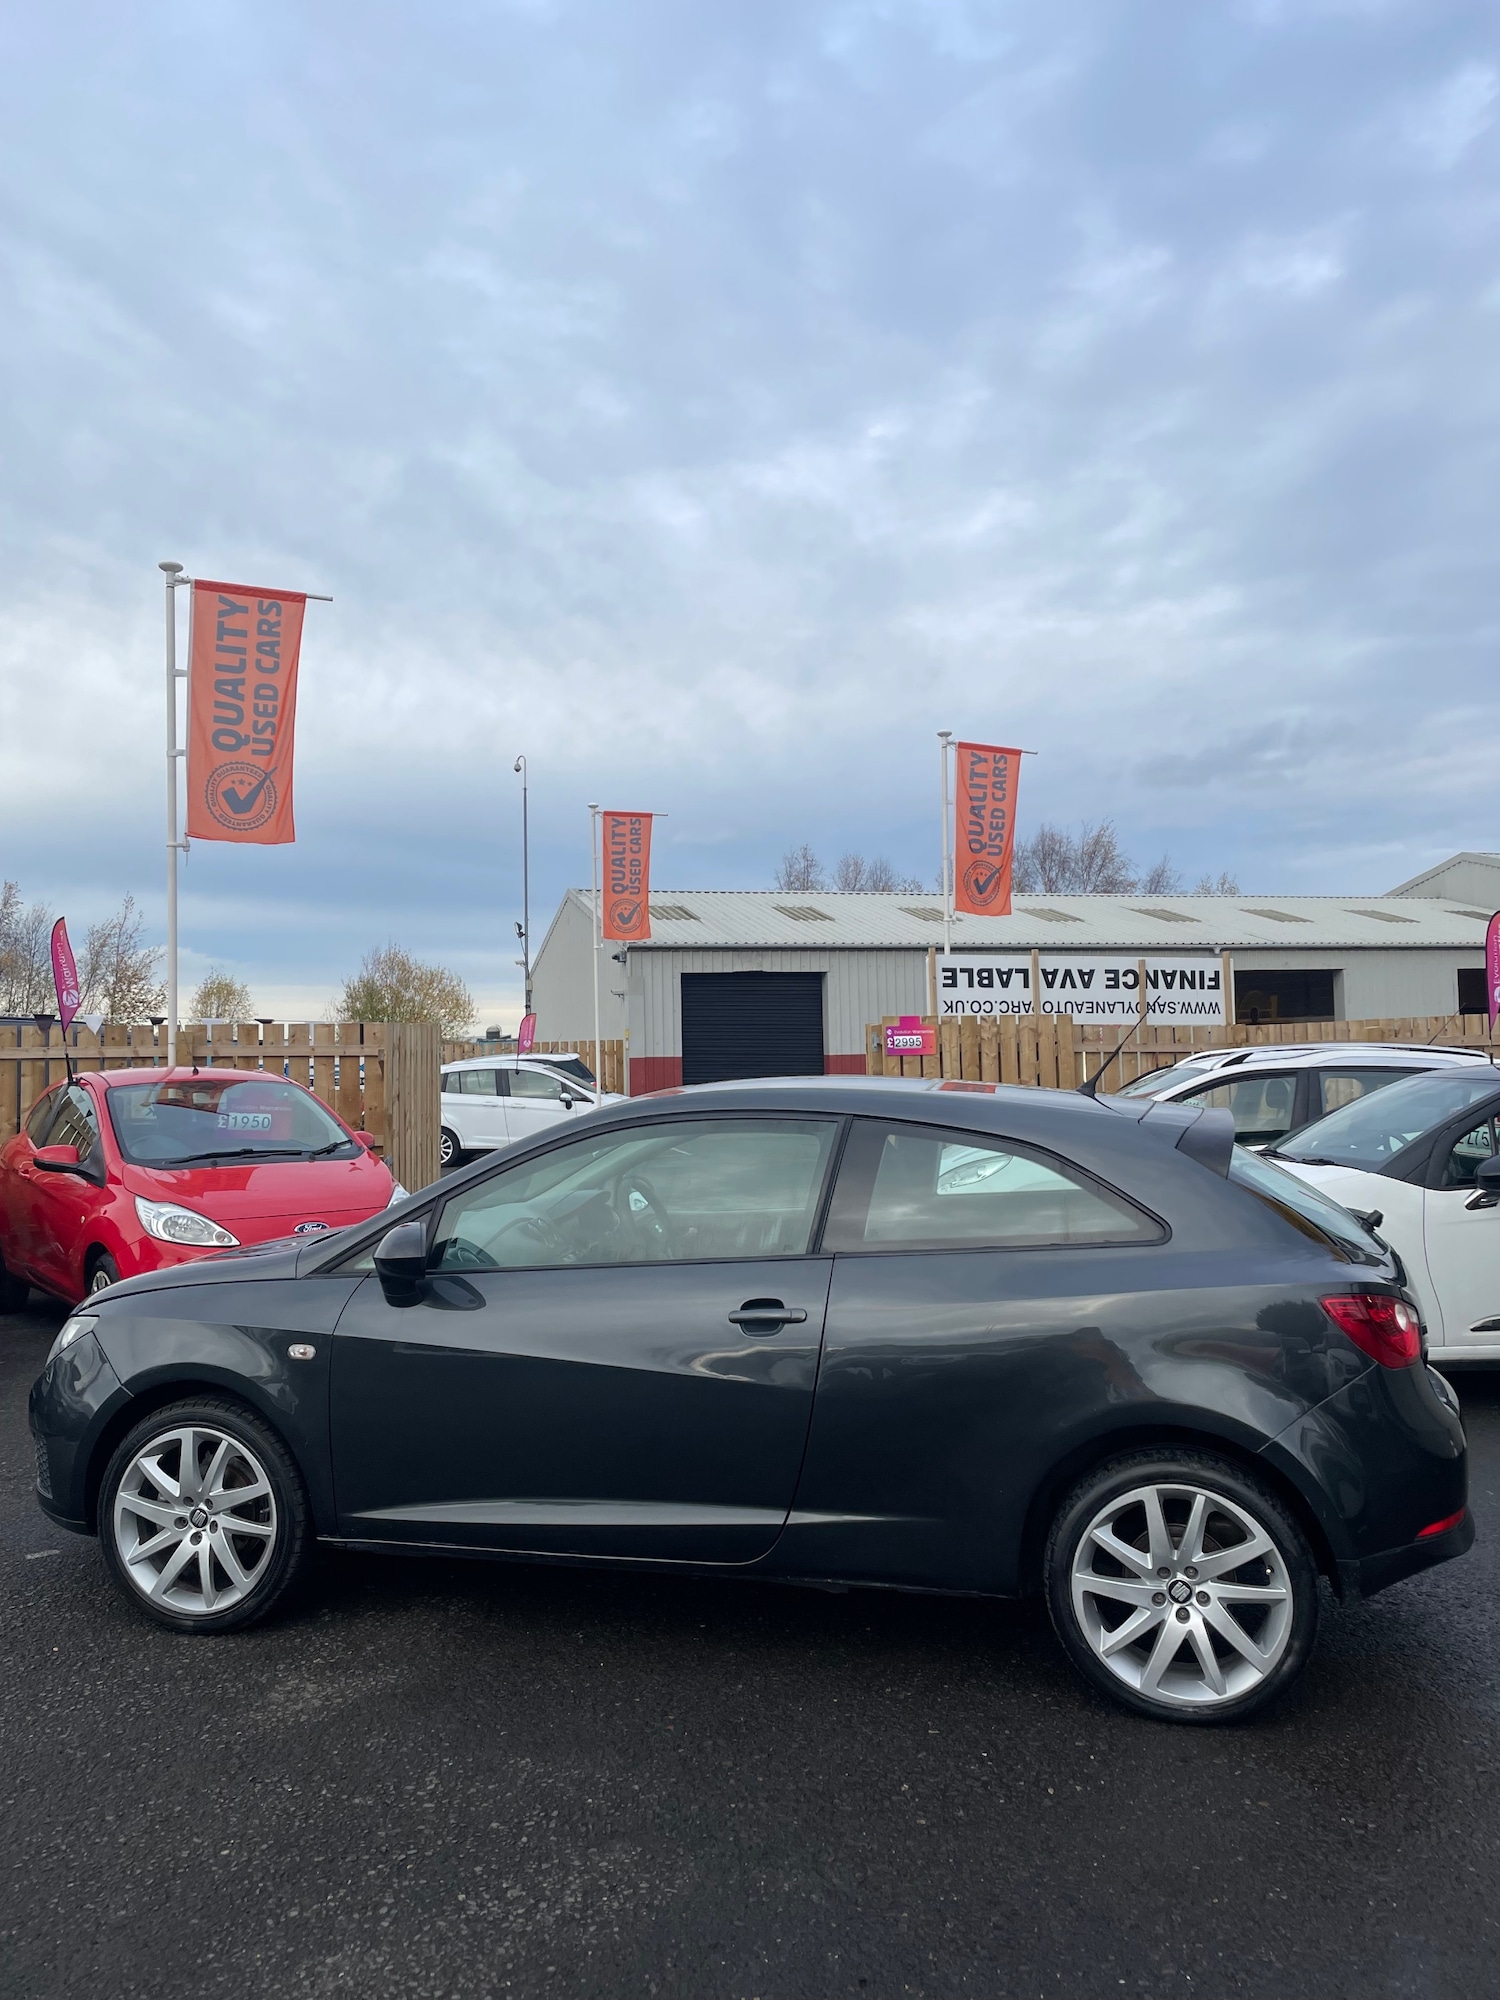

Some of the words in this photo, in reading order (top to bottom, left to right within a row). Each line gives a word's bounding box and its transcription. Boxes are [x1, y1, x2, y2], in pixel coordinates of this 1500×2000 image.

[254, 598, 283, 674] CARS
[211, 594, 251, 753] QUALITY
[251, 683, 280, 757] USED
[209, 778, 218, 807] QUALITY
[216, 764, 264, 779] GUARANTEED
[991, 753, 1008, 803] CARS
[967, 750, 989, 855] QUALITY
[629, 817, 642, 855] CARS
[987, 807, 1007, 857] USED
[611, 817, 629, 895] QUALITY
[629, 858, 642, 896] USED
[941, 967, 1096, 989] AVALABLE
[1105, 968, 1220, 990] FINANCE
[943, 1000, 1221, 1015] WWW.SANYLANEAUTOARC.CO.UK
[887, 1037, 922, 1048] £2995
[217, 1114, 271, 1129] £1950
